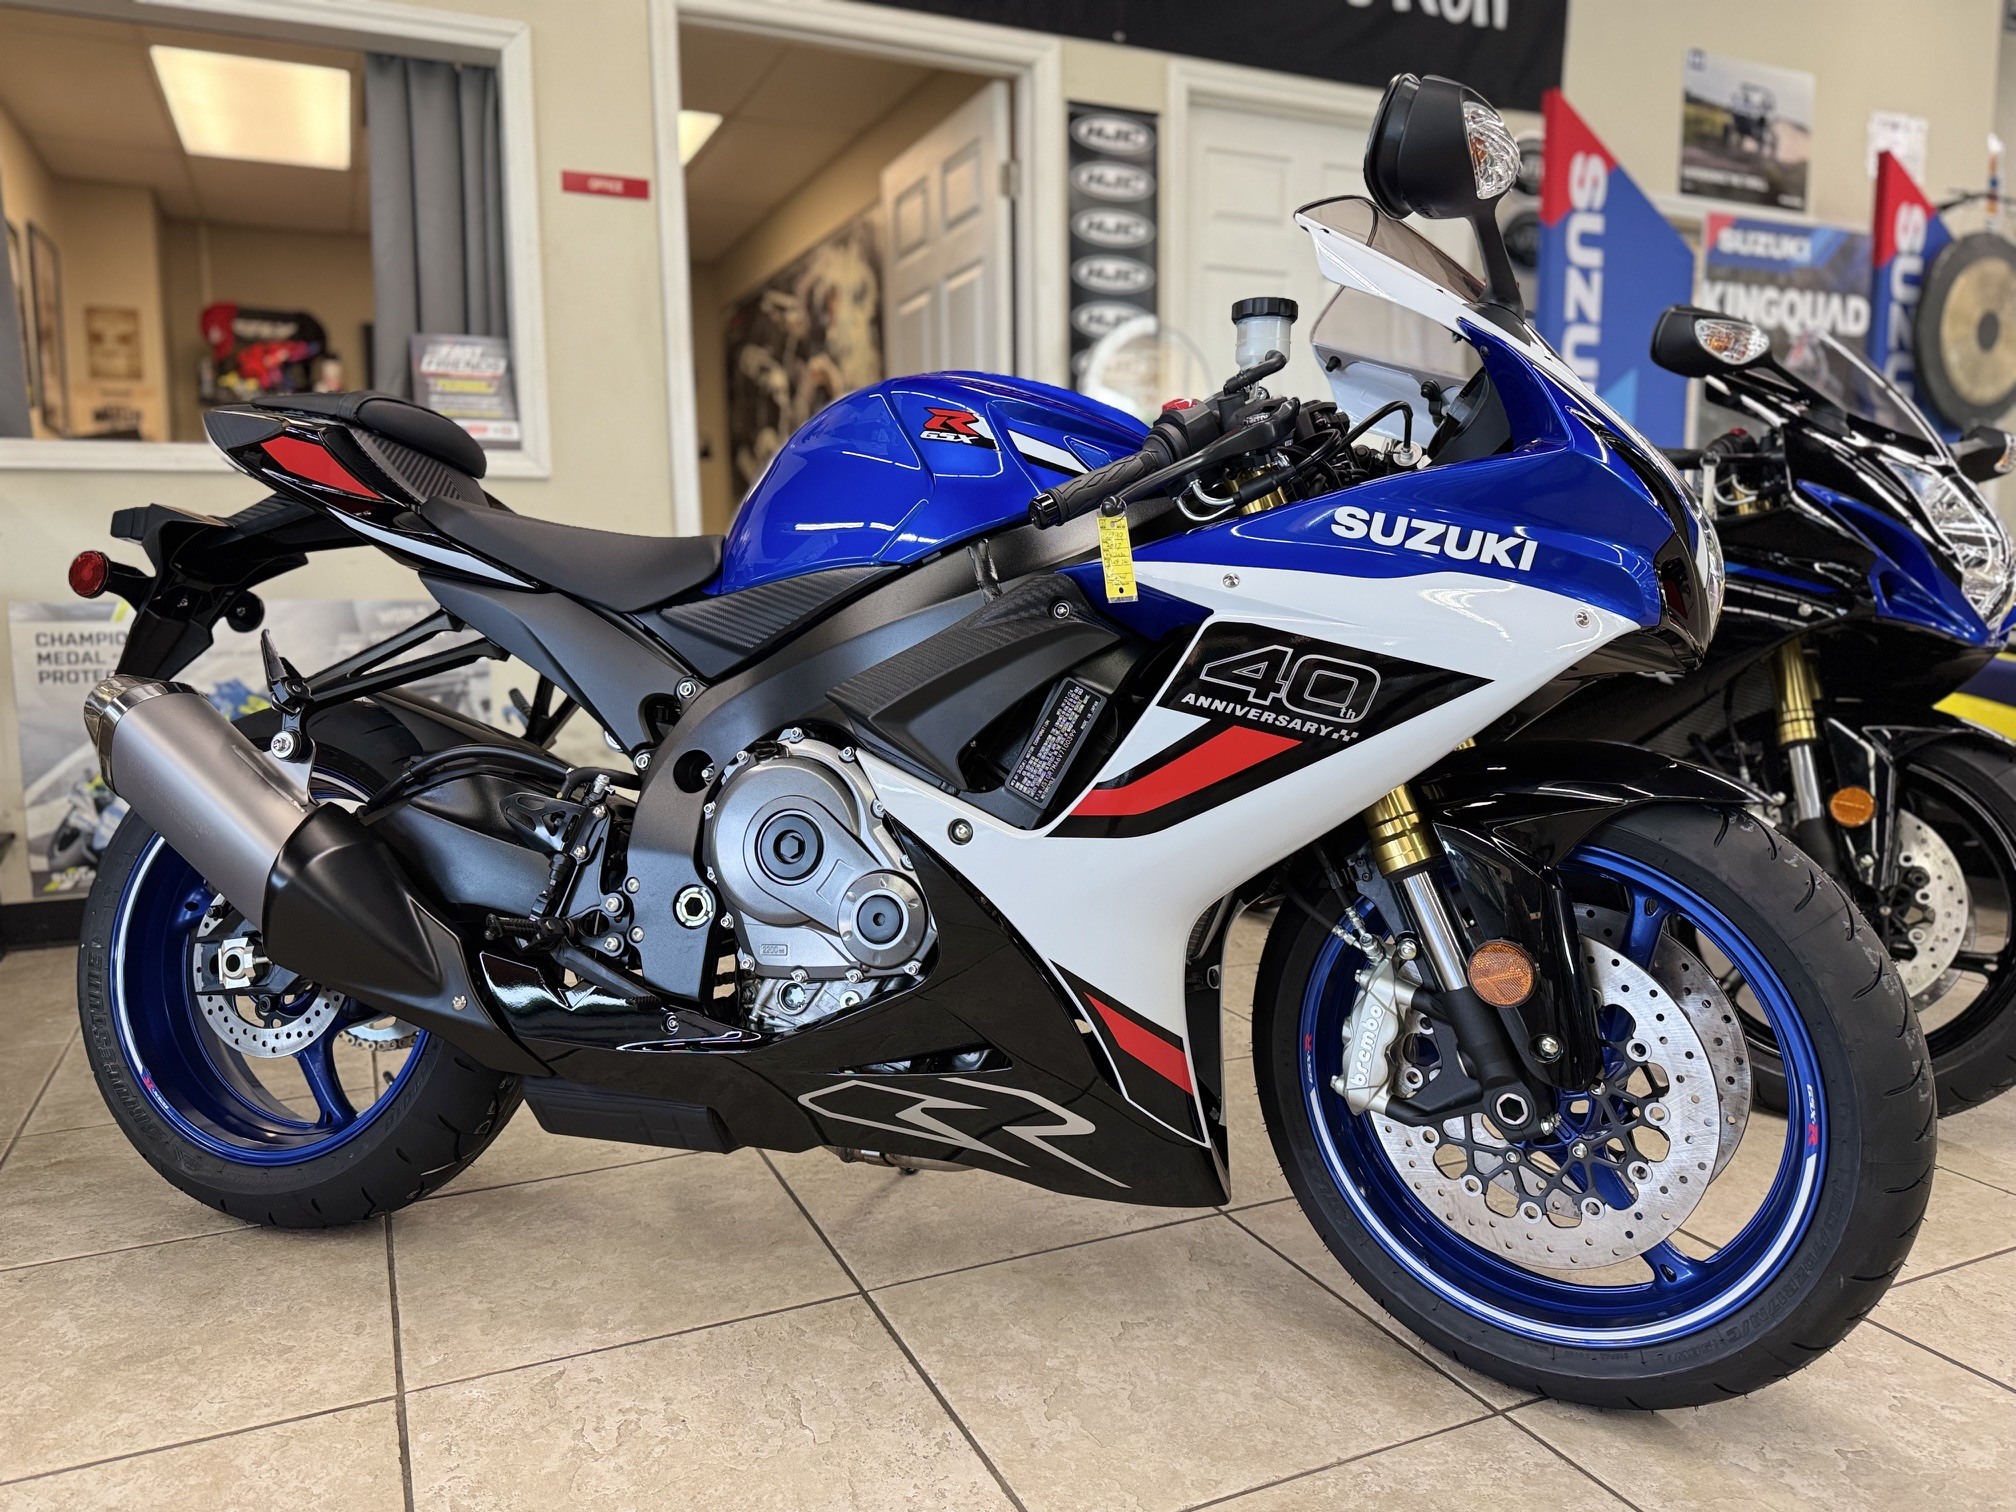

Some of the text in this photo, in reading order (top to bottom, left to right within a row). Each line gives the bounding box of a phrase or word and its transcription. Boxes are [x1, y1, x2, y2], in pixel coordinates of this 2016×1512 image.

[1718, 227, 1812, 263] SUZUKI
[1701, 281, 1871, 337] KINGQUAD
[1331, 506, 1538, 571] SUZUKI
[37, 653, 104, 665] MEDAL
[1181, 692, 1333, 736] ANNIVERSARY
[1350, 1005, 1383, 1086] brembo
